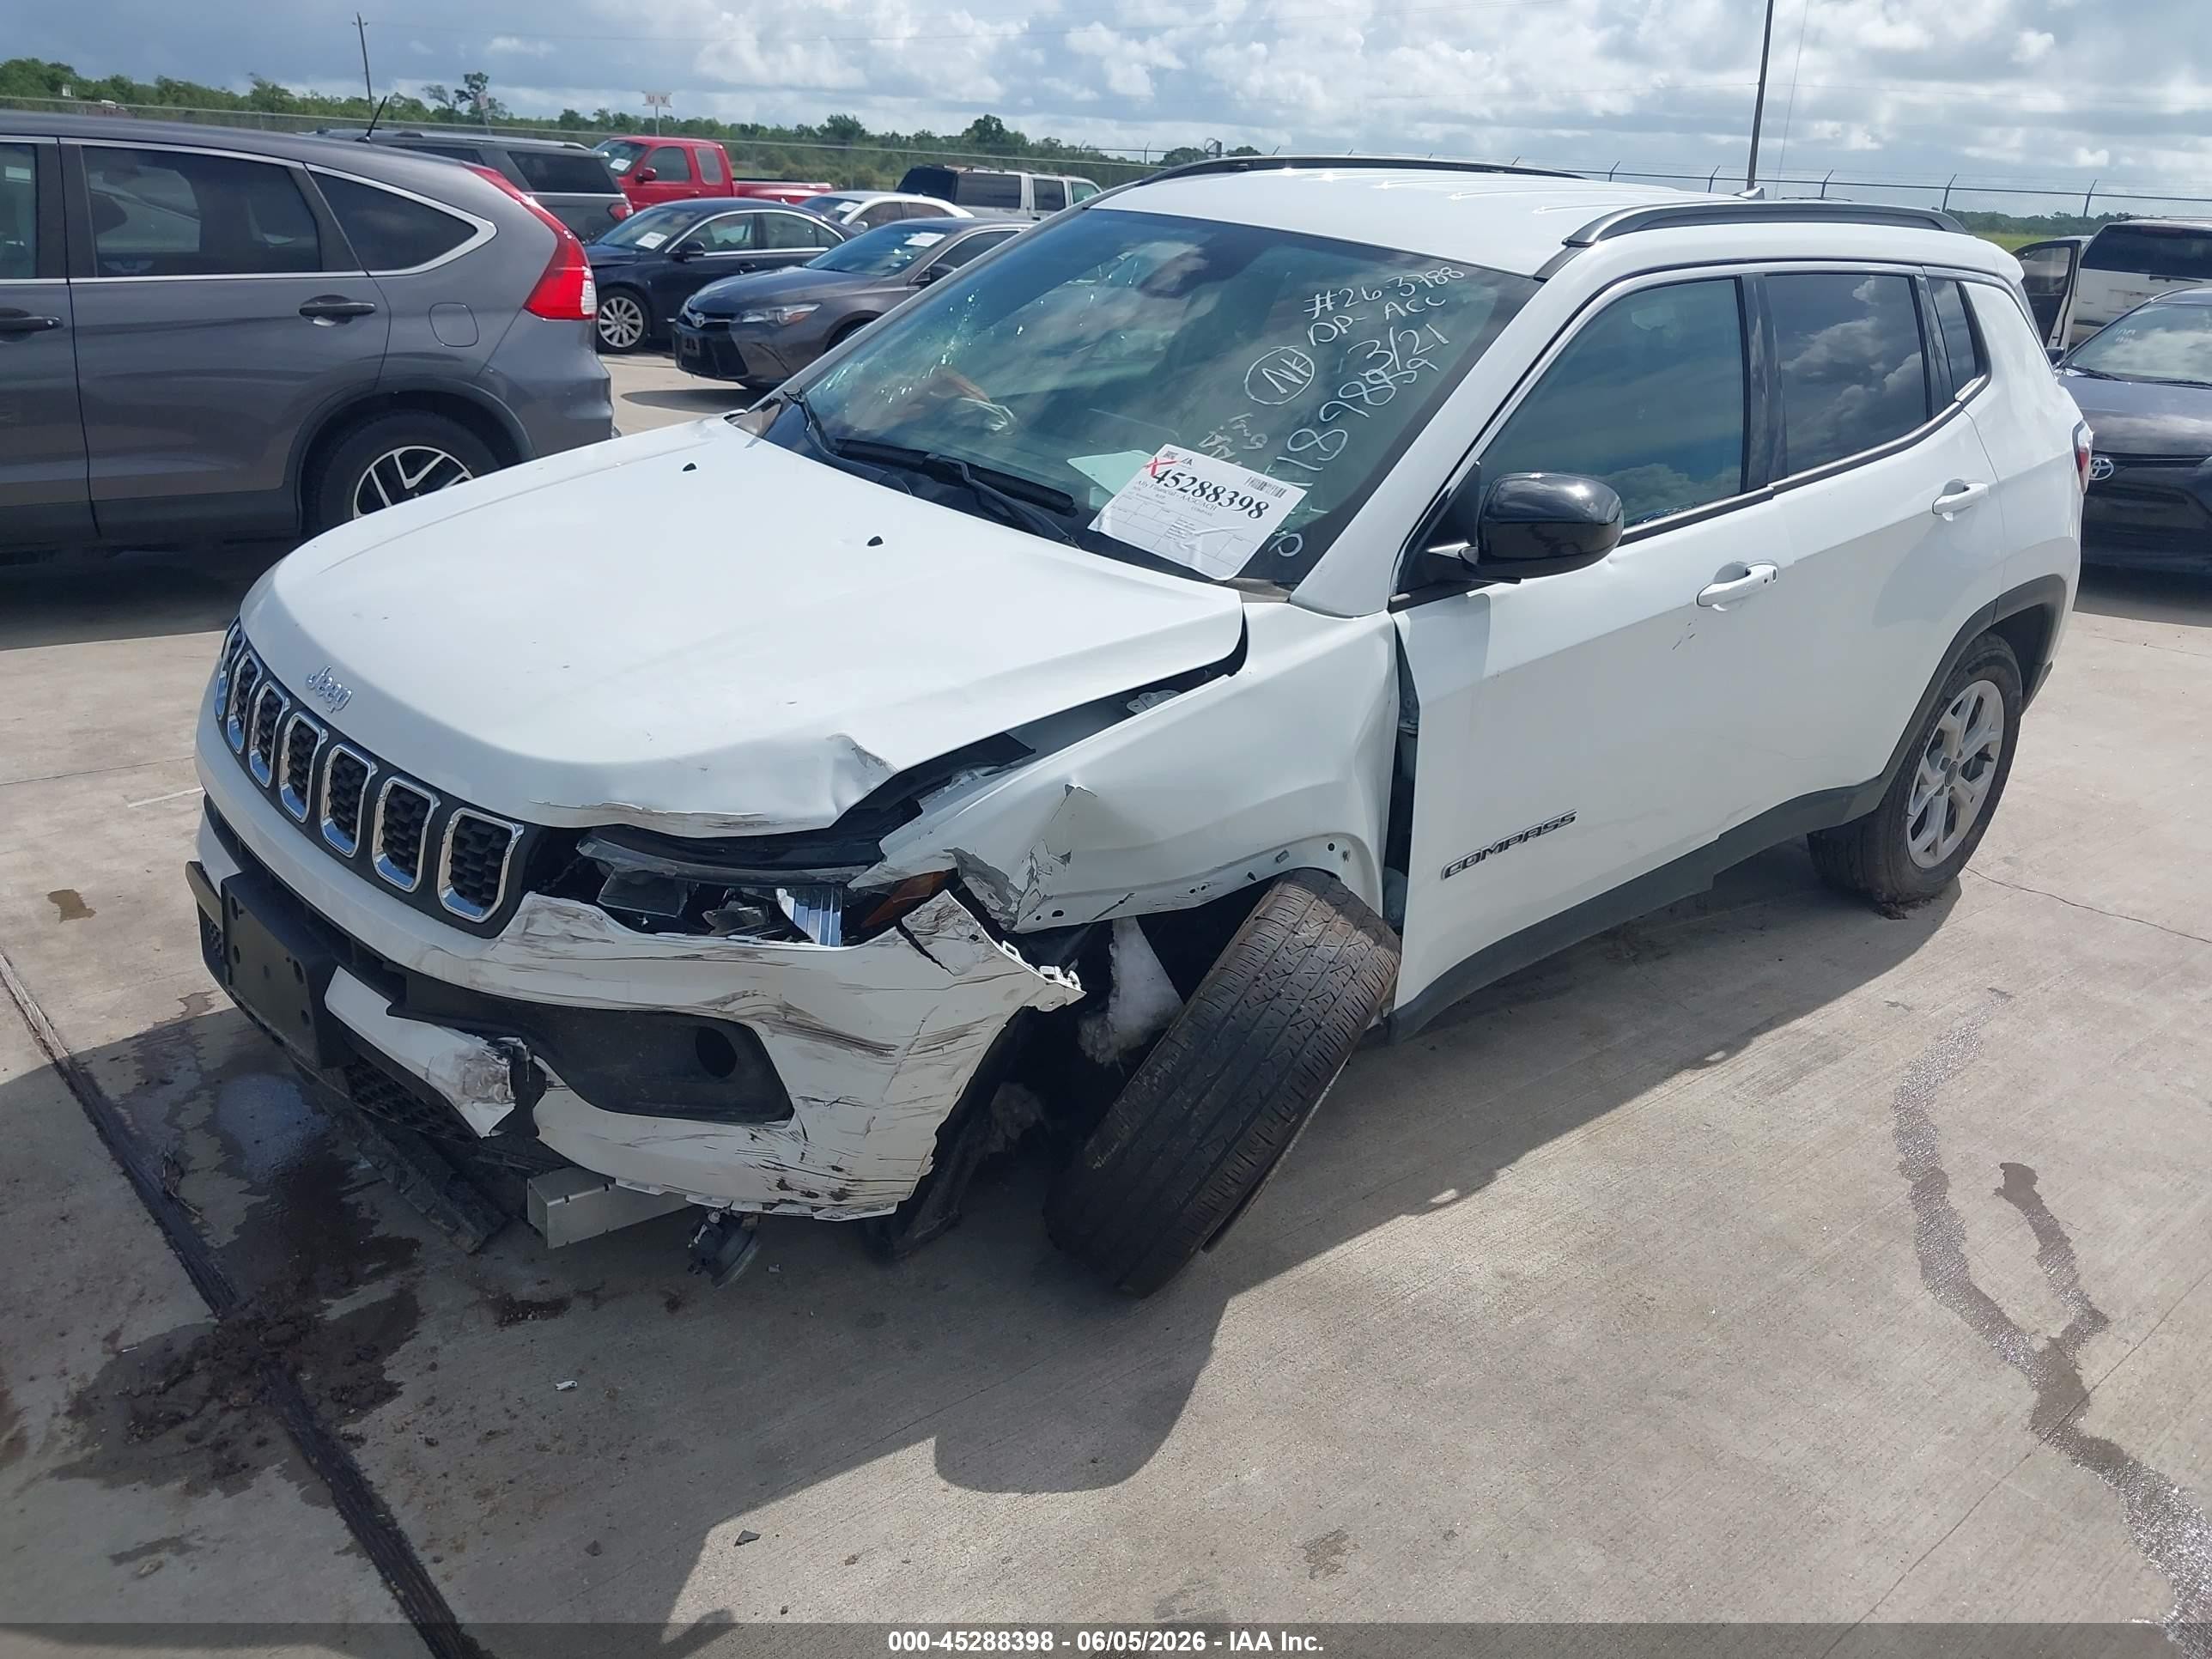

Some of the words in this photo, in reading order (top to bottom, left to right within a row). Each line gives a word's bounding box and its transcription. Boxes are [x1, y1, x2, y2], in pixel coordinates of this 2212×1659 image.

[1152, 469, 1269, 520] 45288398
[307, 665, 353, 714] Jeep
[1440, 808, 1578, 880] COMPASS
